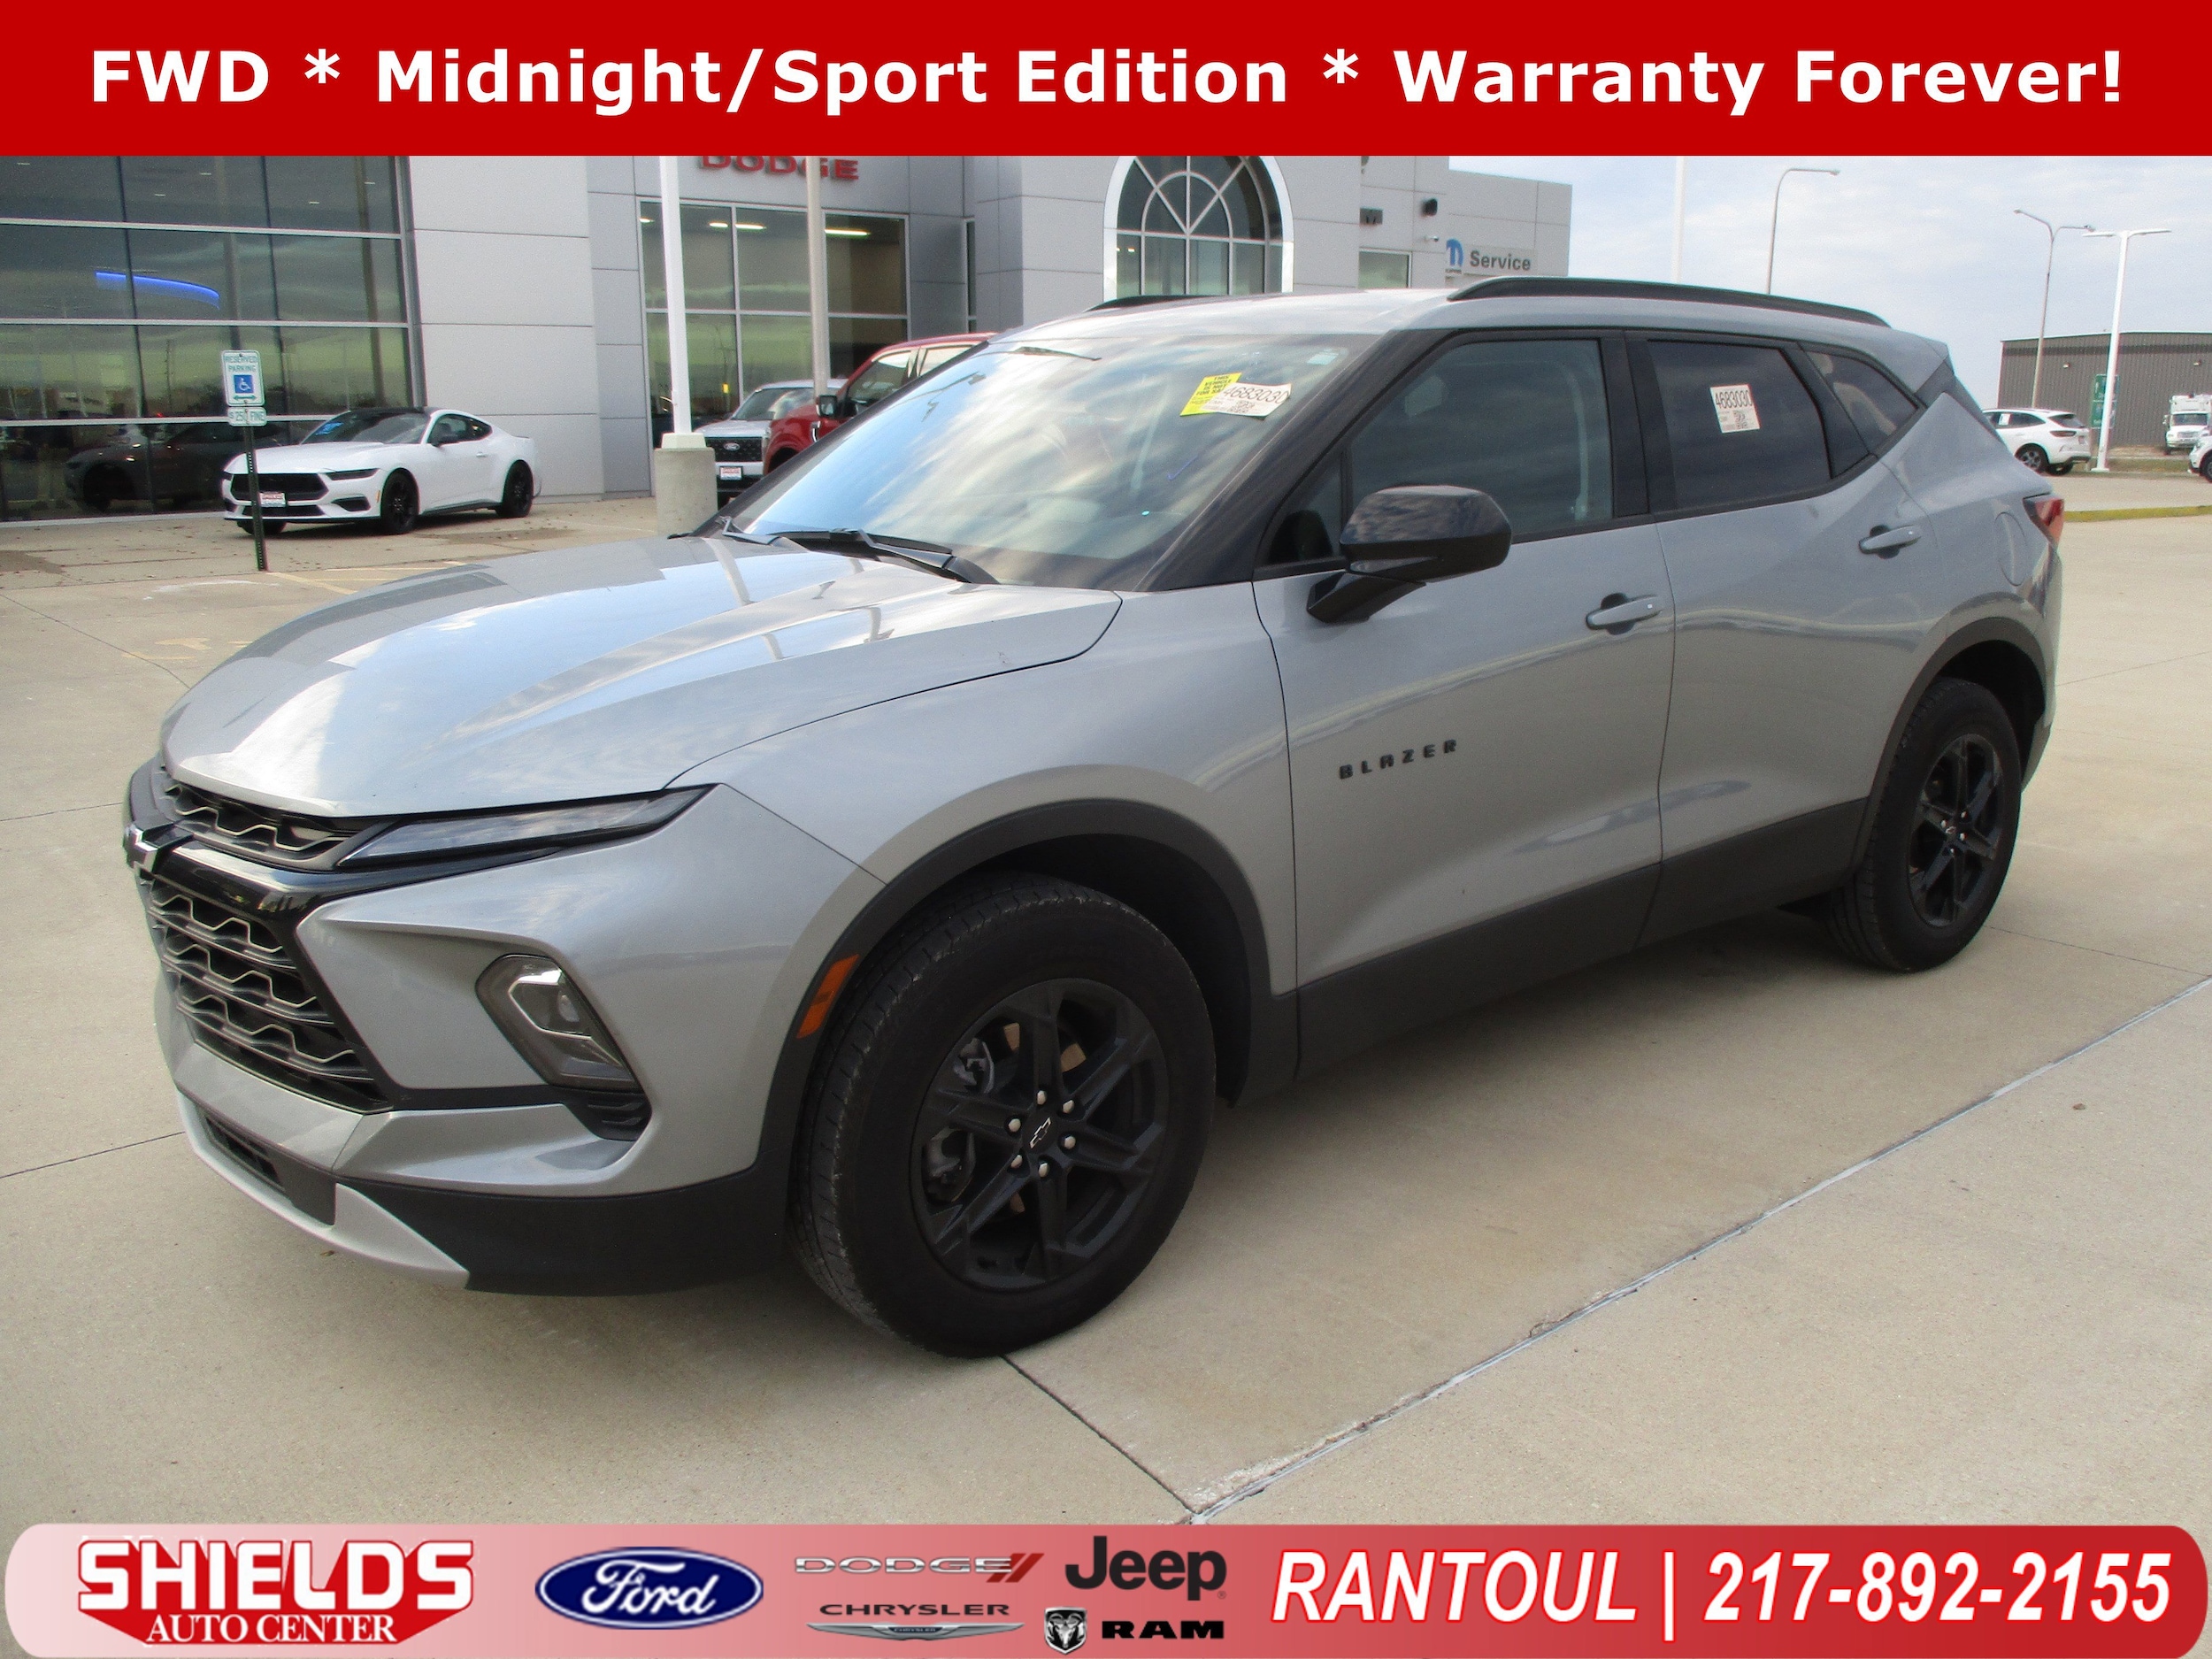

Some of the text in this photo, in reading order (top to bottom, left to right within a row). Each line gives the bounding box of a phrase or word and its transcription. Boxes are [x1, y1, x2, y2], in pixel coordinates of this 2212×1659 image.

[1470, 250, 1531, 271] Service
[1223, 386, 1290, 404] 4683030
[1715, 389, 1753, 409] 4683030
[250, 411, 265, 422] FINE
[1339, 739, 1457, 780] BLAZER
